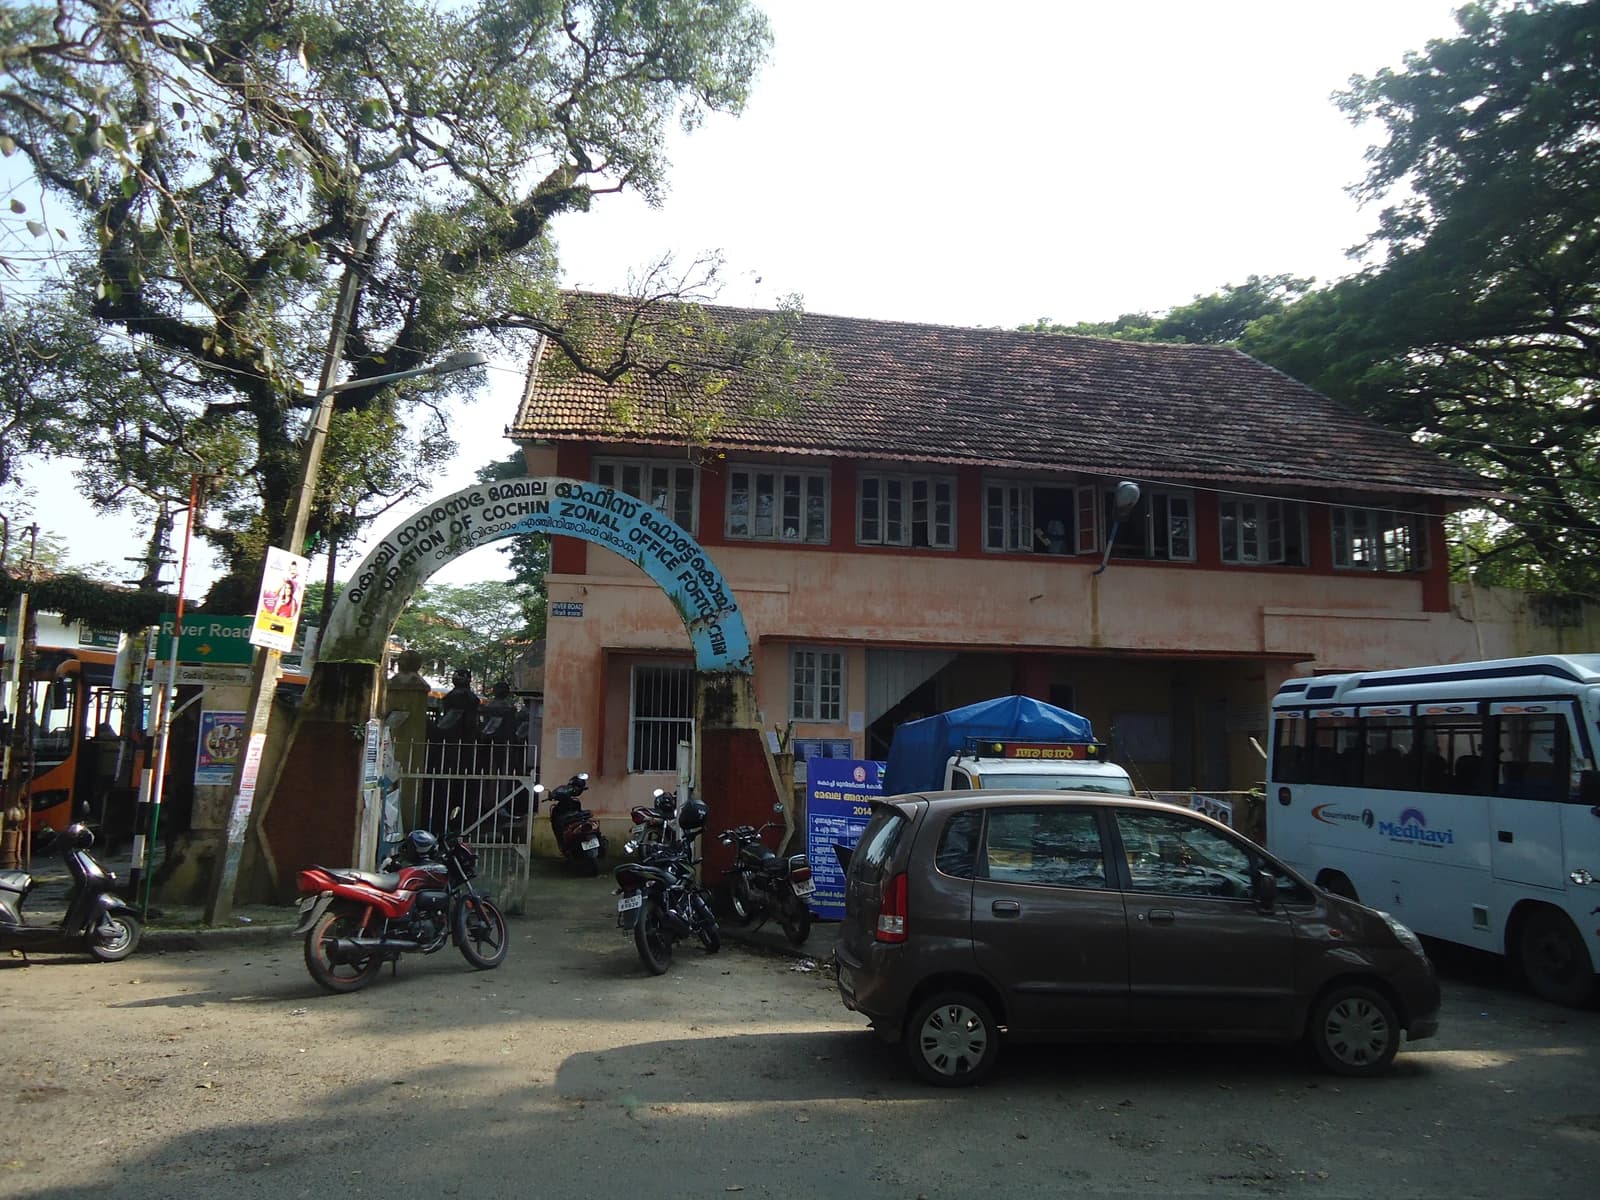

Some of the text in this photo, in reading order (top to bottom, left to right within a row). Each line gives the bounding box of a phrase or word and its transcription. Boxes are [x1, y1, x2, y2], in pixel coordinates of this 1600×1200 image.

[488, 482, 547, 501] മേഖല
[354, 530, 445, 639] COORATION
[450, 514, 472, 534] OF
[482, 501, 550, 522] COCHIN
[560, 502, 620, 532] ZONAL
[629, 527, 681, 571] OFFICE
[162, 621, 252, 638] Rver Road
[853, 806, 872, 815] 2014
[1379, 821, 1454, 844] Medhavi
